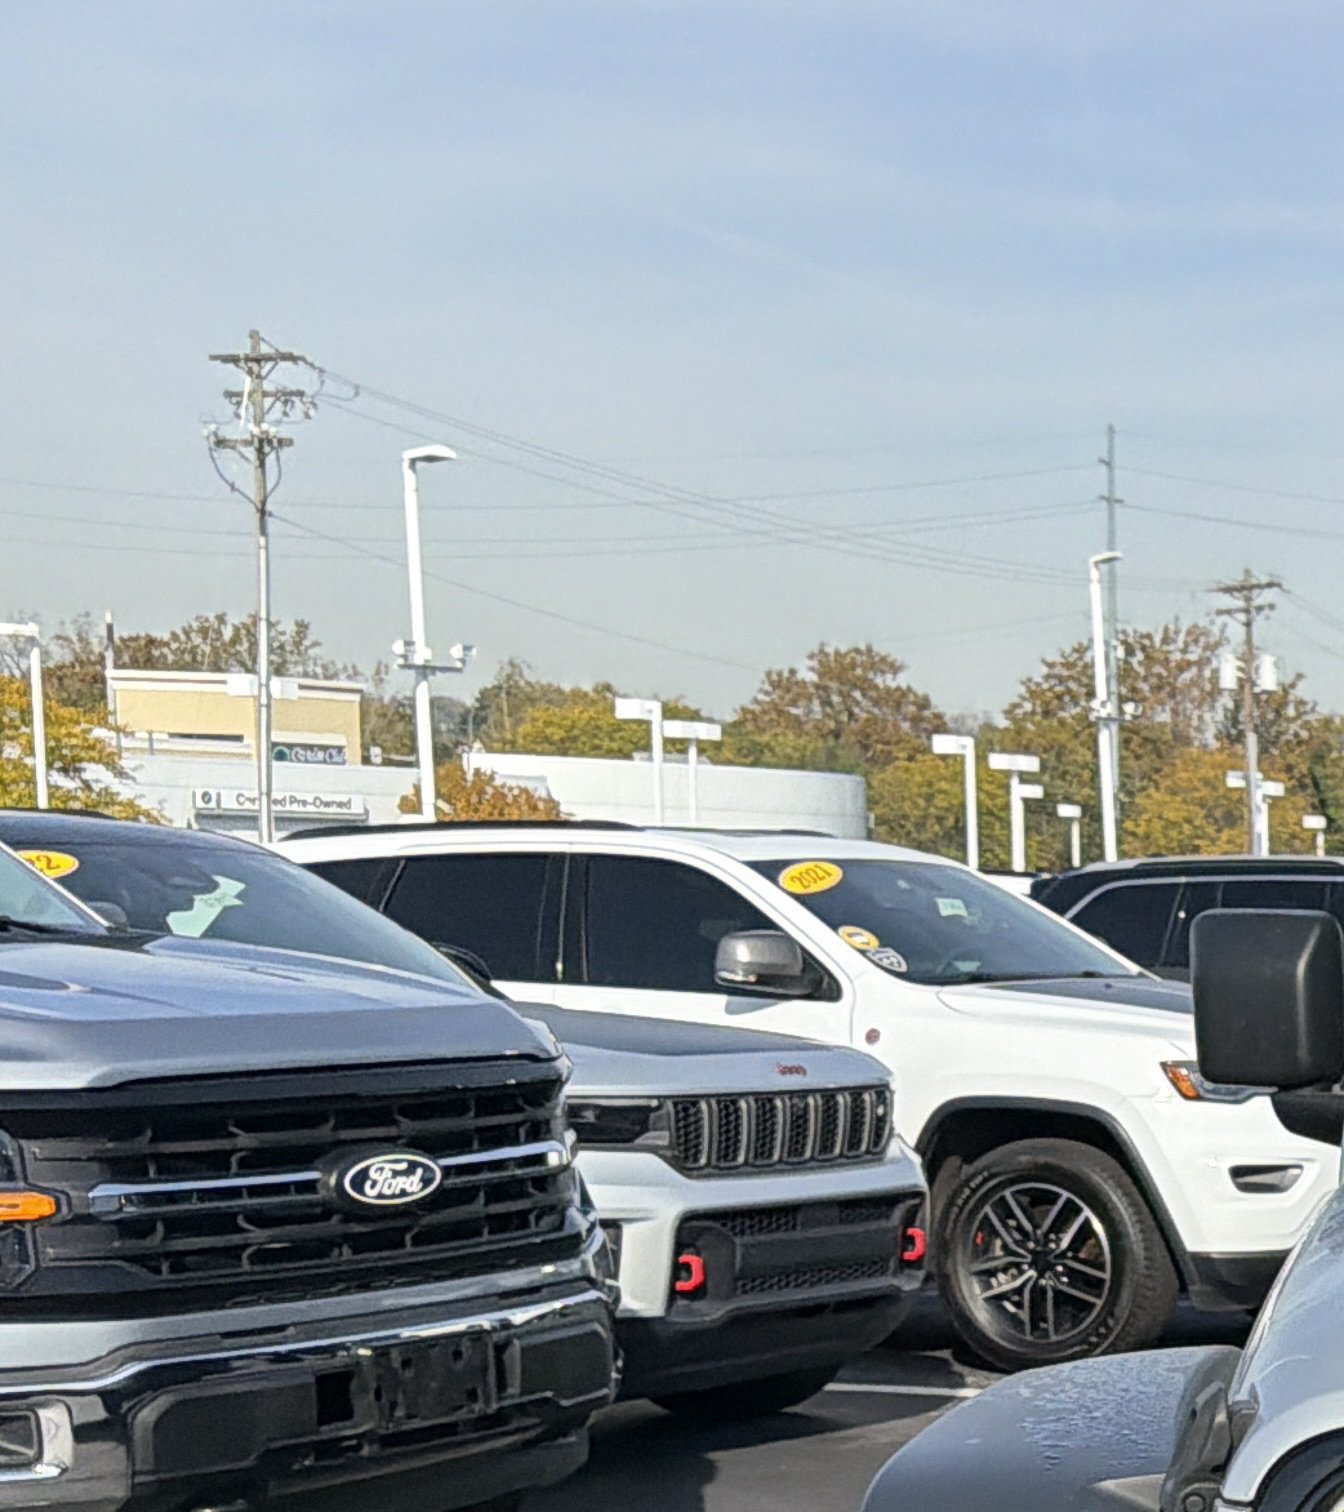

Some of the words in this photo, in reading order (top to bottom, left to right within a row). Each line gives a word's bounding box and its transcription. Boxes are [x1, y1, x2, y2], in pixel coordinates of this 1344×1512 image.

[289, 795, 351, 810] Pre-Owned
[790, 864, 832, 889] 2021
[364, 1161, 424, 1197] Ford
